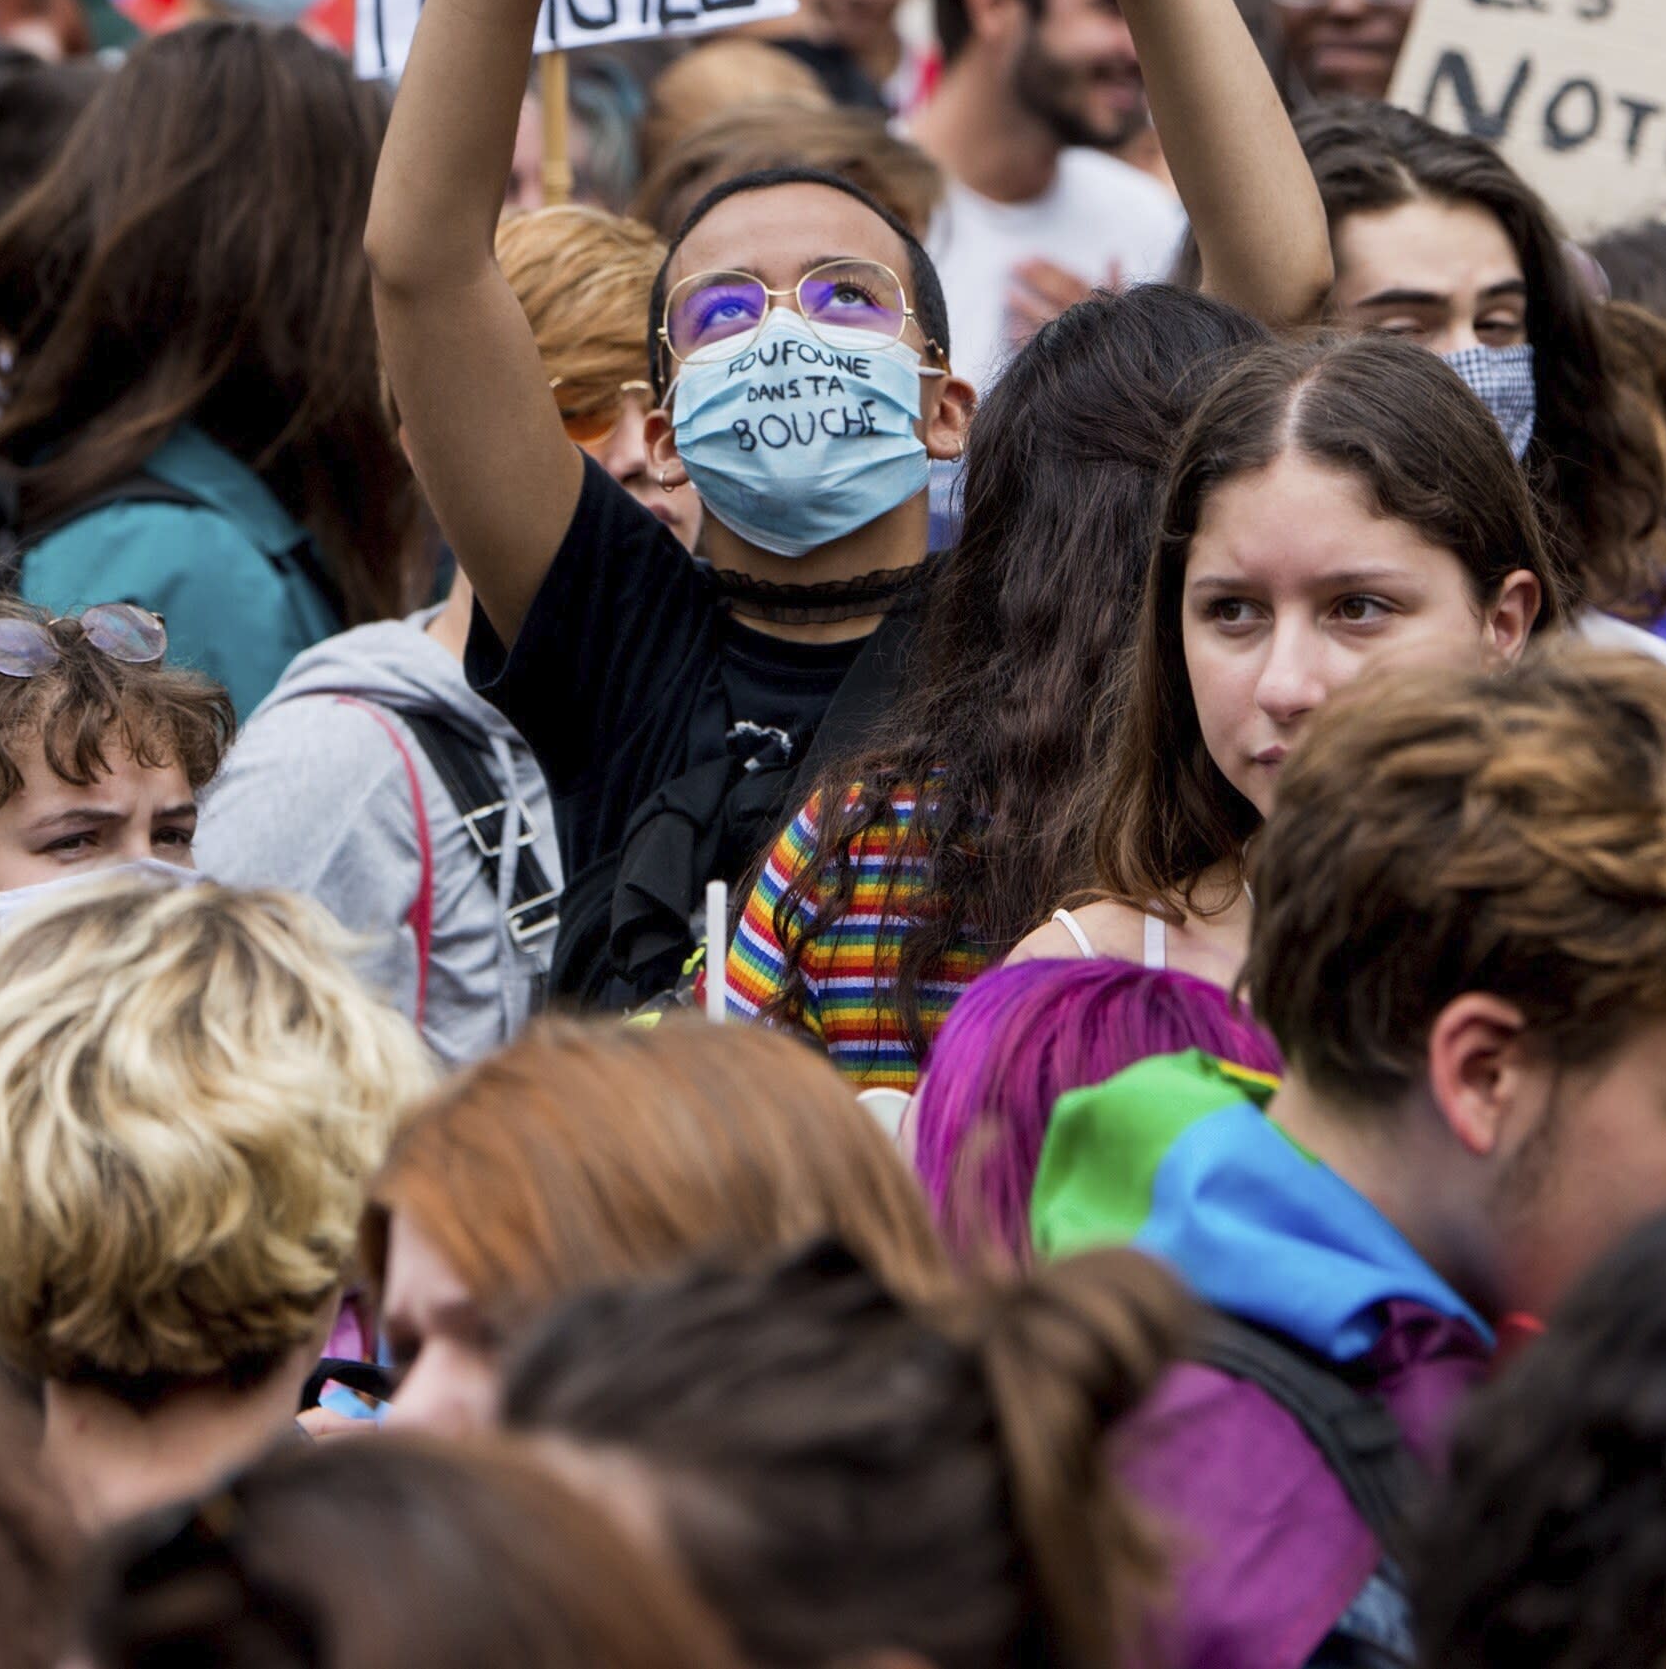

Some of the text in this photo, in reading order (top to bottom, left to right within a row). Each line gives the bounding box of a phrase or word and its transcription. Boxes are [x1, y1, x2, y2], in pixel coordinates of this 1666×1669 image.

[727, 339, 872, 379] FOUFOUNE
[747, 375, 845, 403] DANS TA
[731, 399, 878, 453] BOUCHE
